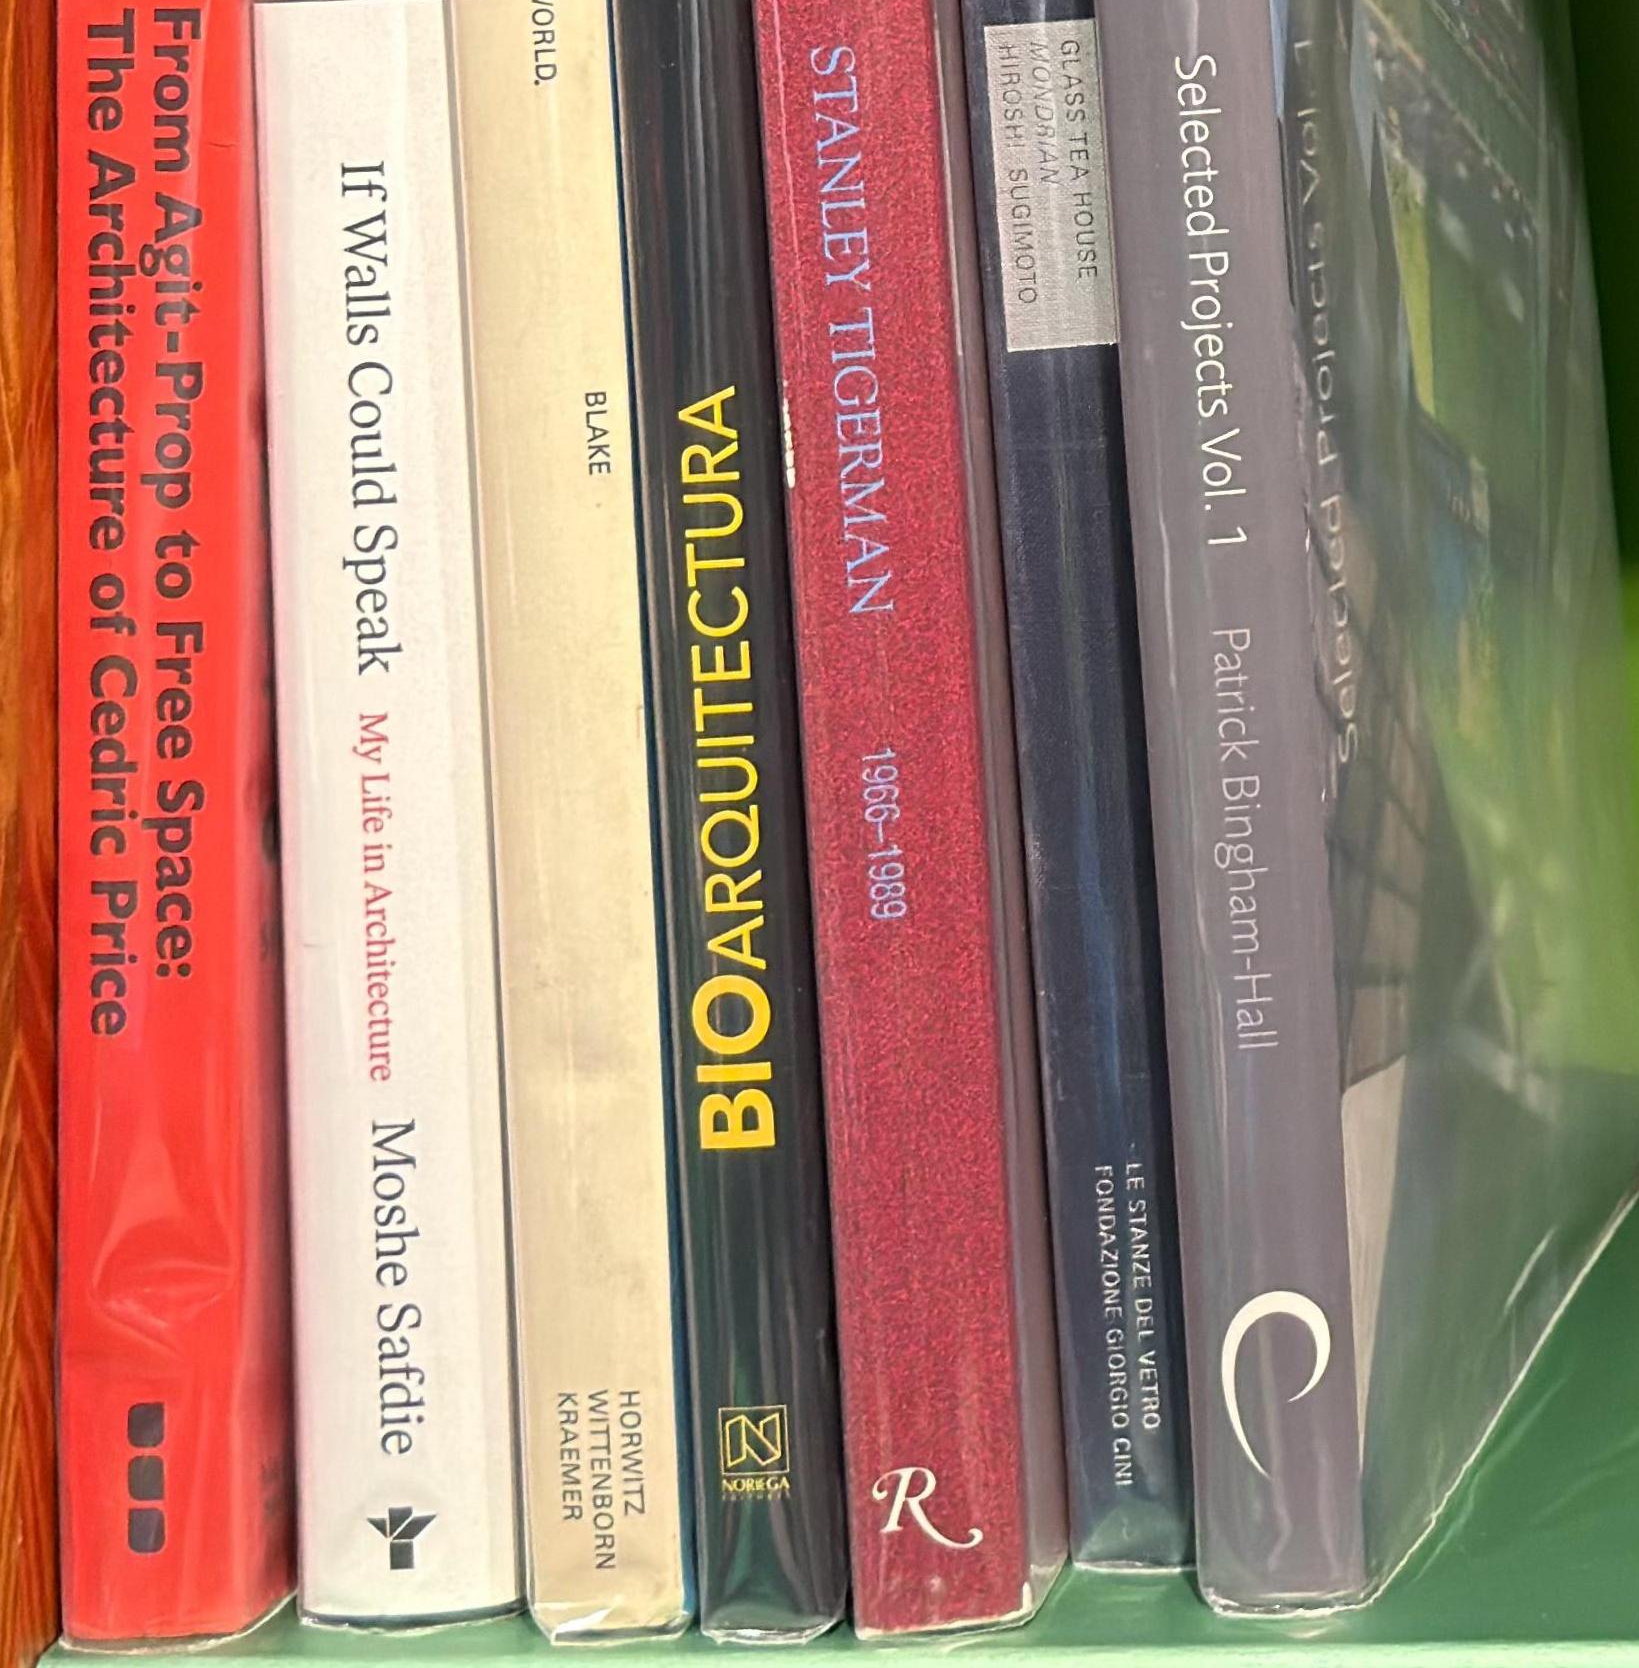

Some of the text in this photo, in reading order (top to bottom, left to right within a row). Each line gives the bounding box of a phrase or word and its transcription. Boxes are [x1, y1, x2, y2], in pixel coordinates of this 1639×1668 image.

[997, 43, 1038, 305] HIROSHI SUGIMOTO
[1027, 39, 1061, 184] MONDRIAN
[1059, 38, 1099, 279] GLASS TEA HOUSE
[339, 160, 403, 676] If Walls Could Speak
[583, 390, 611, 476] BLAKE
[807, 43, 895, 615] STANLEY TIGERMAN
[1173, 53, 1248, 545] Selected Projects Vol. 1
[86, 6, 138, 1036] The Architecture of Cedric Price
[137, 6, 205, 978] From Agit-Prop to Free Space:
[352, 713, 396, 1082] My Life in Architecture
[677, 385, 776, 1149] BIOARQUITECTURA
[1211, 627, 1279, 1050] Patrick Bingham-Hall
[371, 1117, 425, 1455] Moshe Safdie
[1093, 1164, 1133, 1486] FONDAZIONE GIORGIO CINI
[1124, 1161, 1160, 1430] LE STANZE DEL VETRO
[556, 1392, 583, 1521] KRAEMER
[588, 1387, 616, 1570] WITTENBORN
[618, 1389, 645, 1517] HORWITZ
